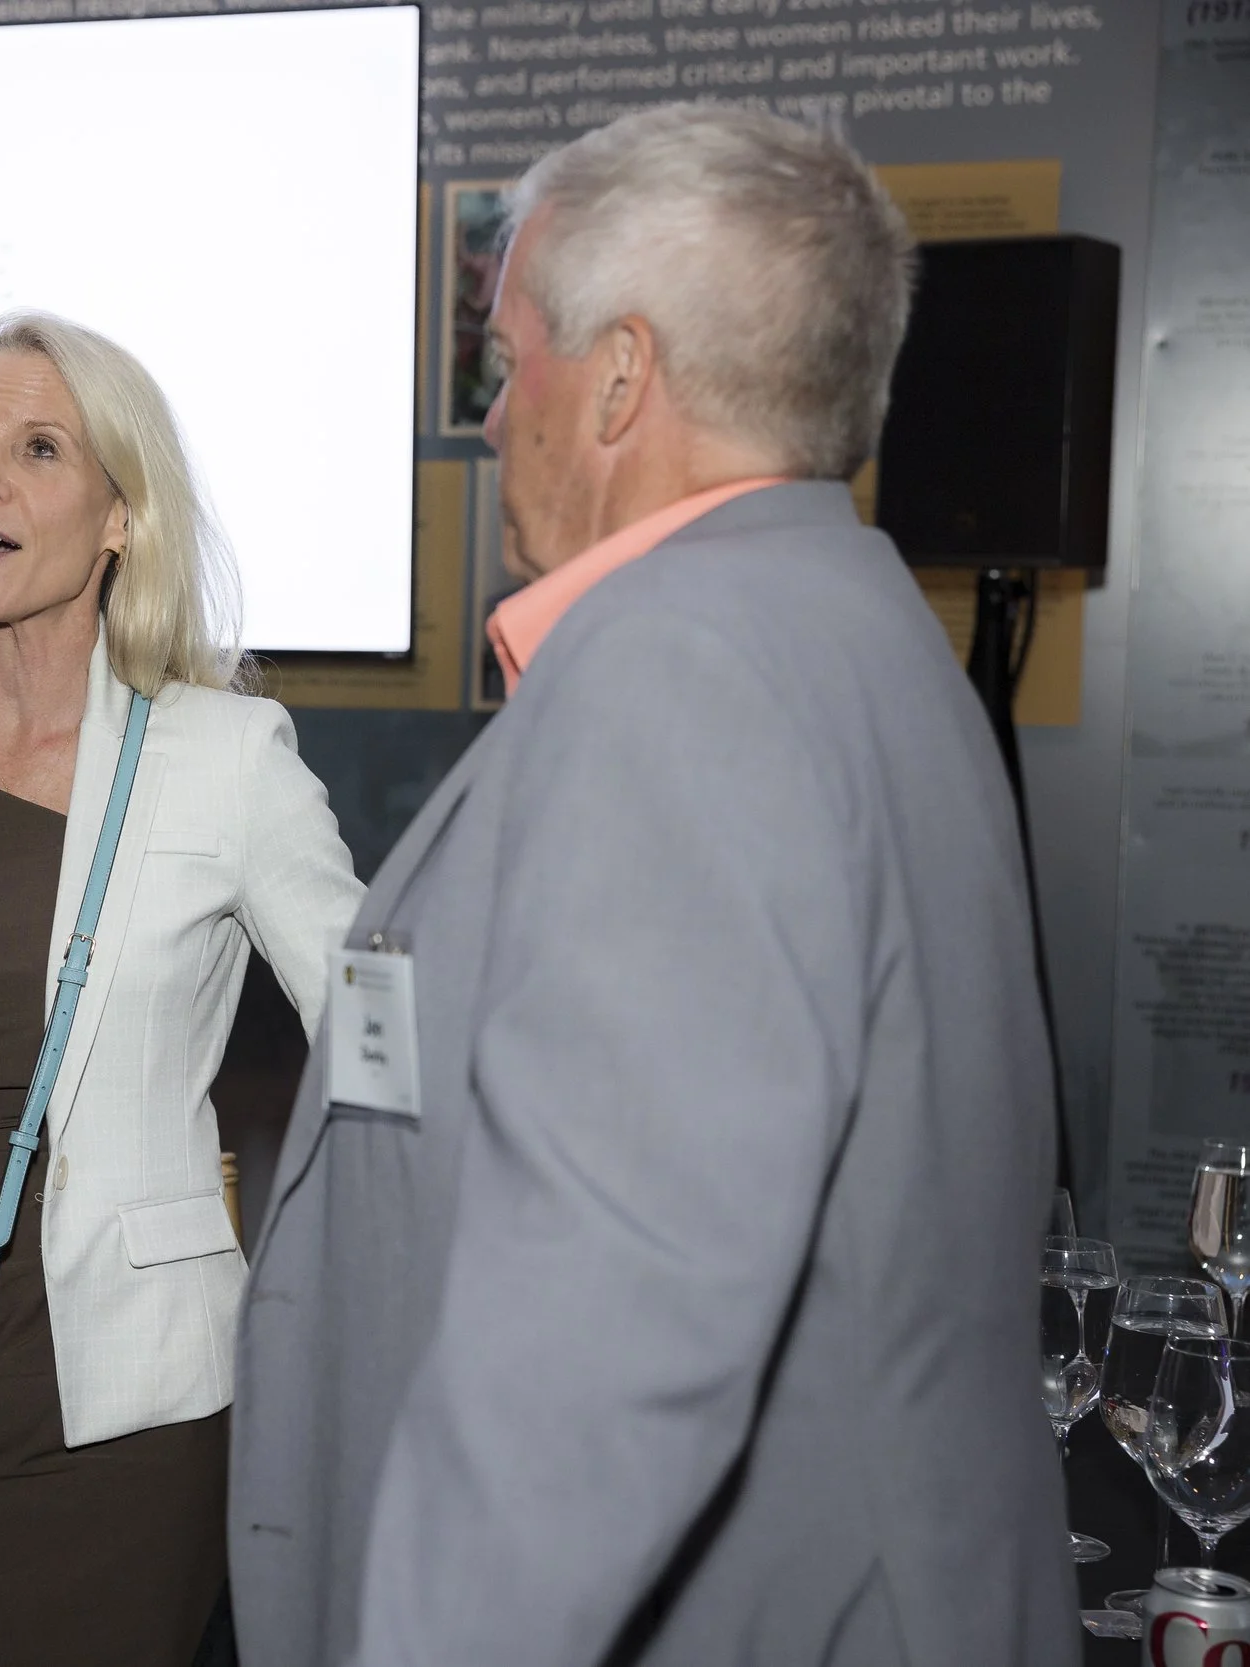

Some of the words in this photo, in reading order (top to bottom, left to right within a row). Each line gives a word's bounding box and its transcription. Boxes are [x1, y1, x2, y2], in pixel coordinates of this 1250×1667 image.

[424, 39, 482, 66] ank.
[487, 28, 658, 61] Nonetheless,
[663, 26, 740, 53] these
[744, 21, 851, 47] women
[857, 9, 945, 41] risked
[952, 6, 1023, 36] their
[1030, 4, 1103, 31] lives,
[430, 6, 477, 31] the
[480, 1, 585, 30] military
[474, 67, 527, 97] and
[531, 60, 677, 99] performed
[681, 53, 773, 87] critical
[779, 52, 835, 81] and
[841, 45, 987, 82] important
[994, 38, 1081, 69] work.
[444, 101, 562, 133] women's
[853, 79, 953, 118] pivotal
[961, 83, 994, 107] to
[1001, 75, 1052, 105] the
